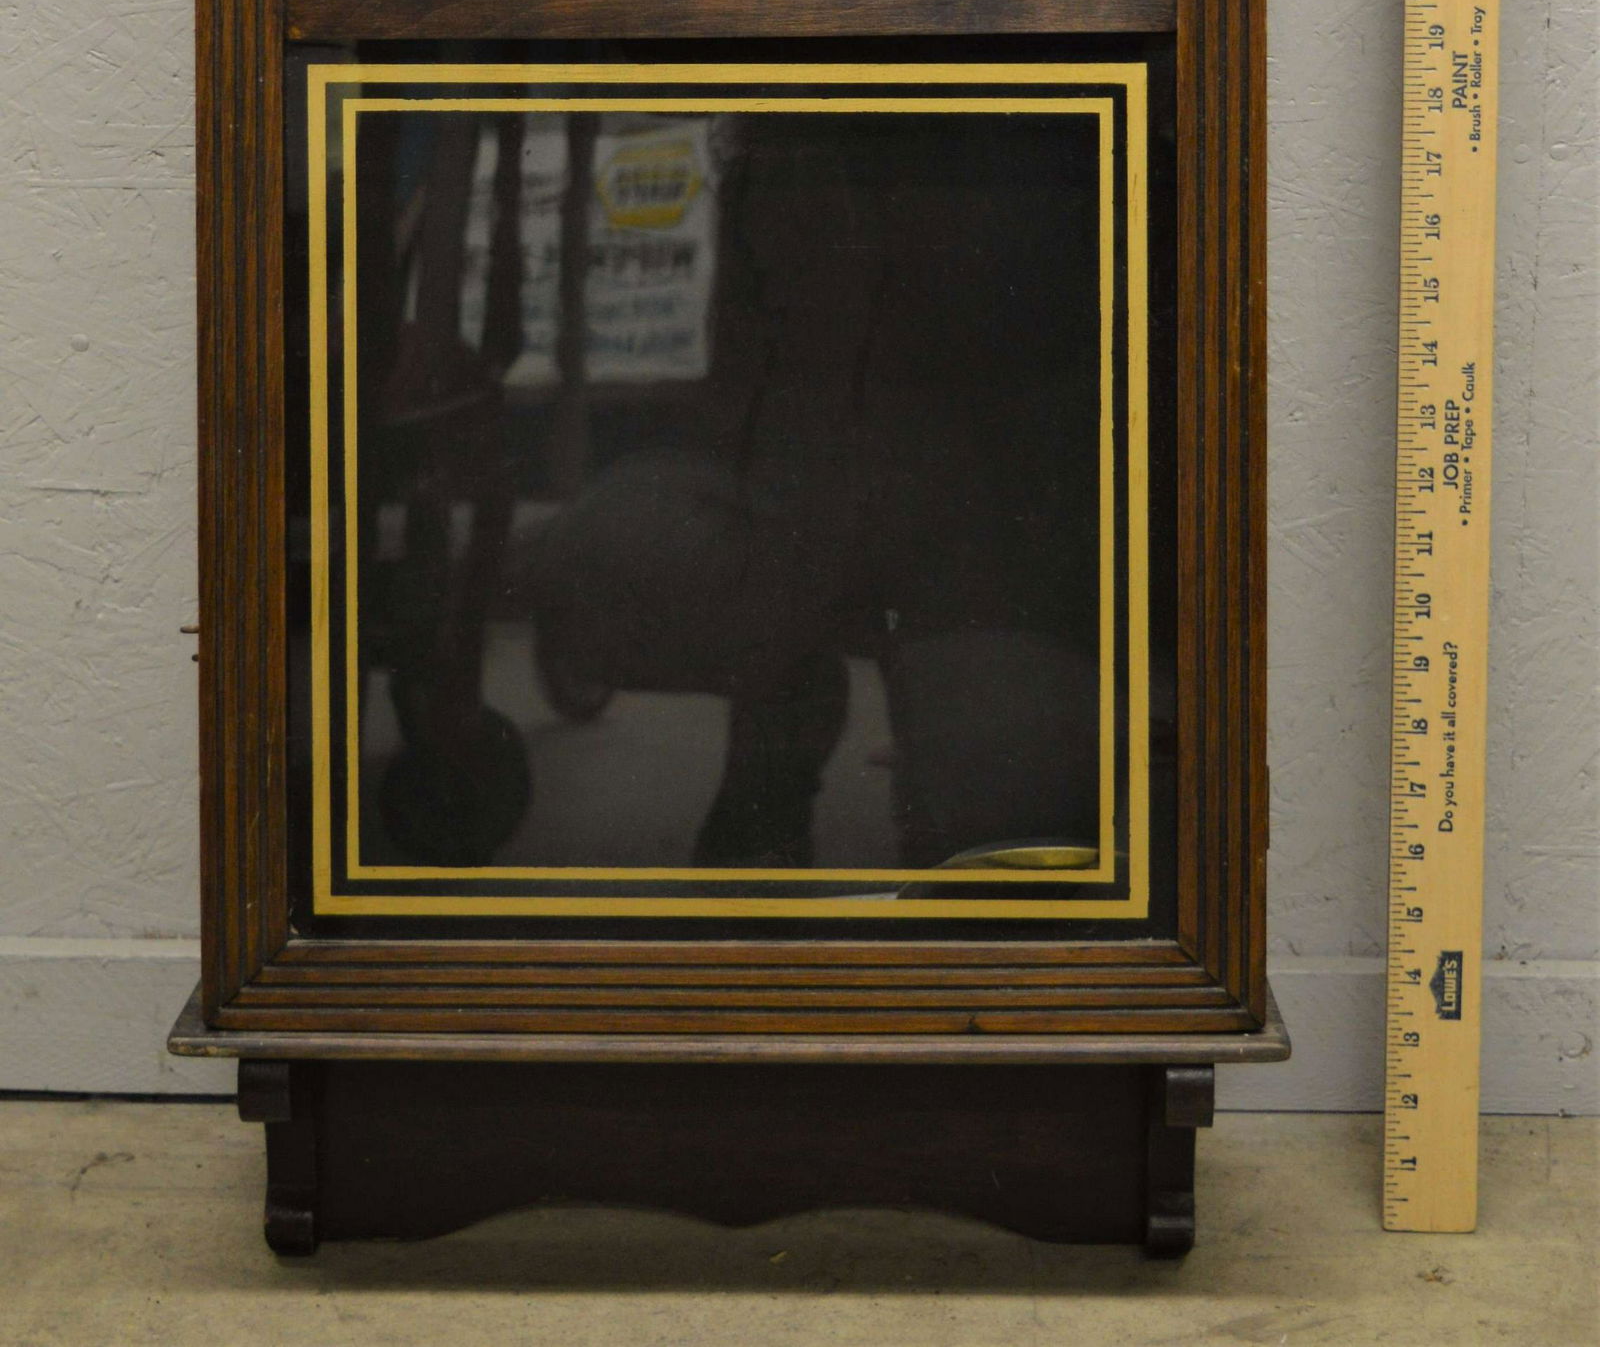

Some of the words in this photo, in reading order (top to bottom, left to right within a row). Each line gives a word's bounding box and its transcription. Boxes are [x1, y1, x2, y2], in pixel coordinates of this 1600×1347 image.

[1471, 6, 1485, 35] Tray
[1428, 24, 1445, 50] 19
[1451, 51, 1468, 109] PAINT
[1470, 52, 1482, 88] Roller
[1427, 87, 1444, 113] 18
[1468, 104, 1481, 141] Brush
[1425, 151, 1442, 176] 17
[1424, 214, 1440, 240] 16
[1422, 278, 1438, 303] 15
[1421, 341, 1438, 366] 14
[1461, 362, 1475, 401] Caulk
[1419, 404, 1436, 429] 13
[1444, 400, 1460, 445] PREP
[1461, 419, 1477, 451] Tape
[1417, 467, 1434, 492] 12
[1443, 452, 1459, 490] JOB
[1460, 470, 1474, 514] Primer
[1416, 531, 1433, 556] 11
[1414, 593, 1431, 619] 10
[1412, 656, 1428, 668] 9
[1442, 642, 1458, 708] covered?
[1410, 718, 1427, 730] 8
[1440, 712, 1457, 727] all
[1441, 731, 1456, 741] it
[1440, 745, 1456, 777] have
[1409, 781, 1425, 792] 7
[1441, 781, 1458, 807] you
[1438, 811, 1455, 832] Do
[1408, 844, 1424, 856] 6
[1407, 906, 1422, 918] 5
[1406, 969, 1421, 980] 4
[1441, 958, 1458, 1011] LOWE'S
[1404, 1032, 1419, 1043] 3
[1402, 1094, 1417, 1106] 2
[1401, 1157, 1416, 1166] 1
